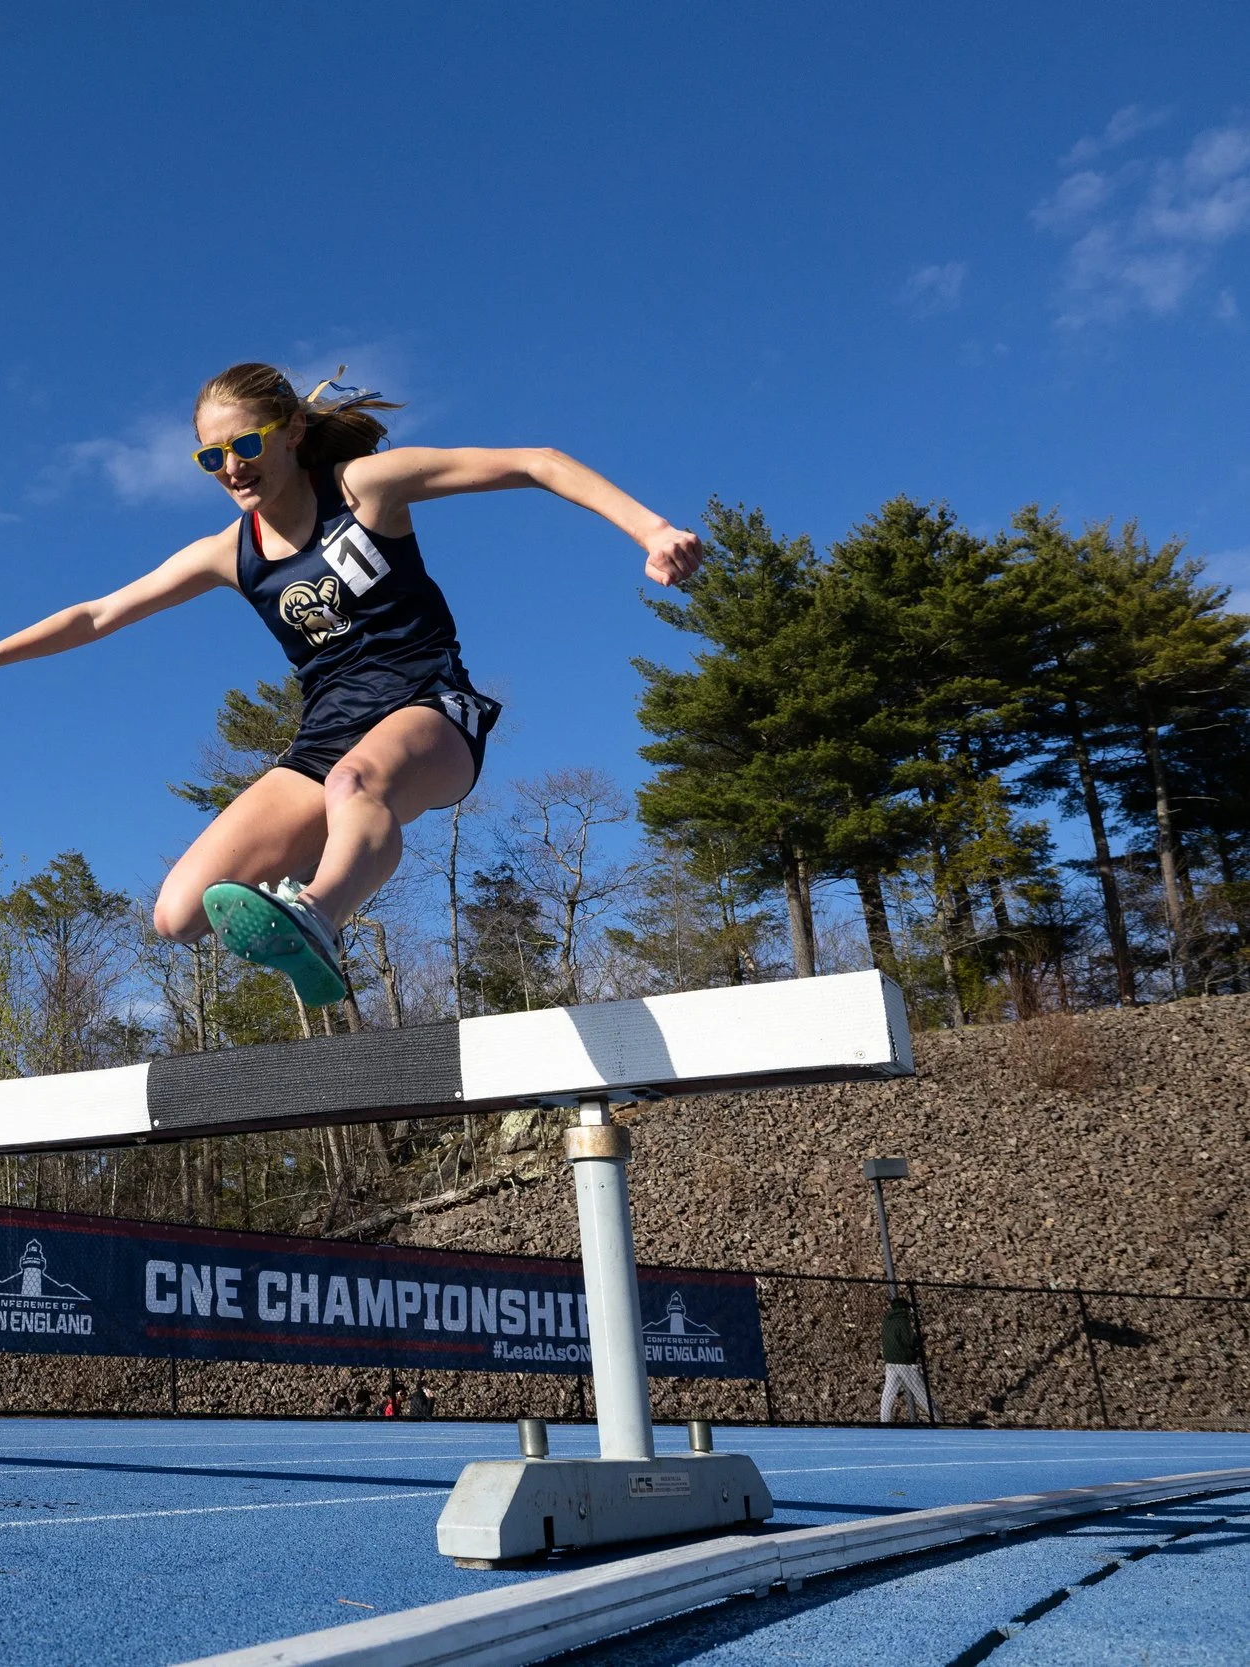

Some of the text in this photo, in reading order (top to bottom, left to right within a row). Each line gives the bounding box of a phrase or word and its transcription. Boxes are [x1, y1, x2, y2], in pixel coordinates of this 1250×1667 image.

[337, 536, 379, 581] 1
[145, 1259, 244, 1319] CNE
[61, 1302, 76, 1310] OF
[10, 1311, 92, 1335] ENGLAND
[646, 1336, 698, 1344] CONFERENCE
[665, 1346, 724, 1363] ENGLAND
[630, 1477, 654, 1494] UCS
